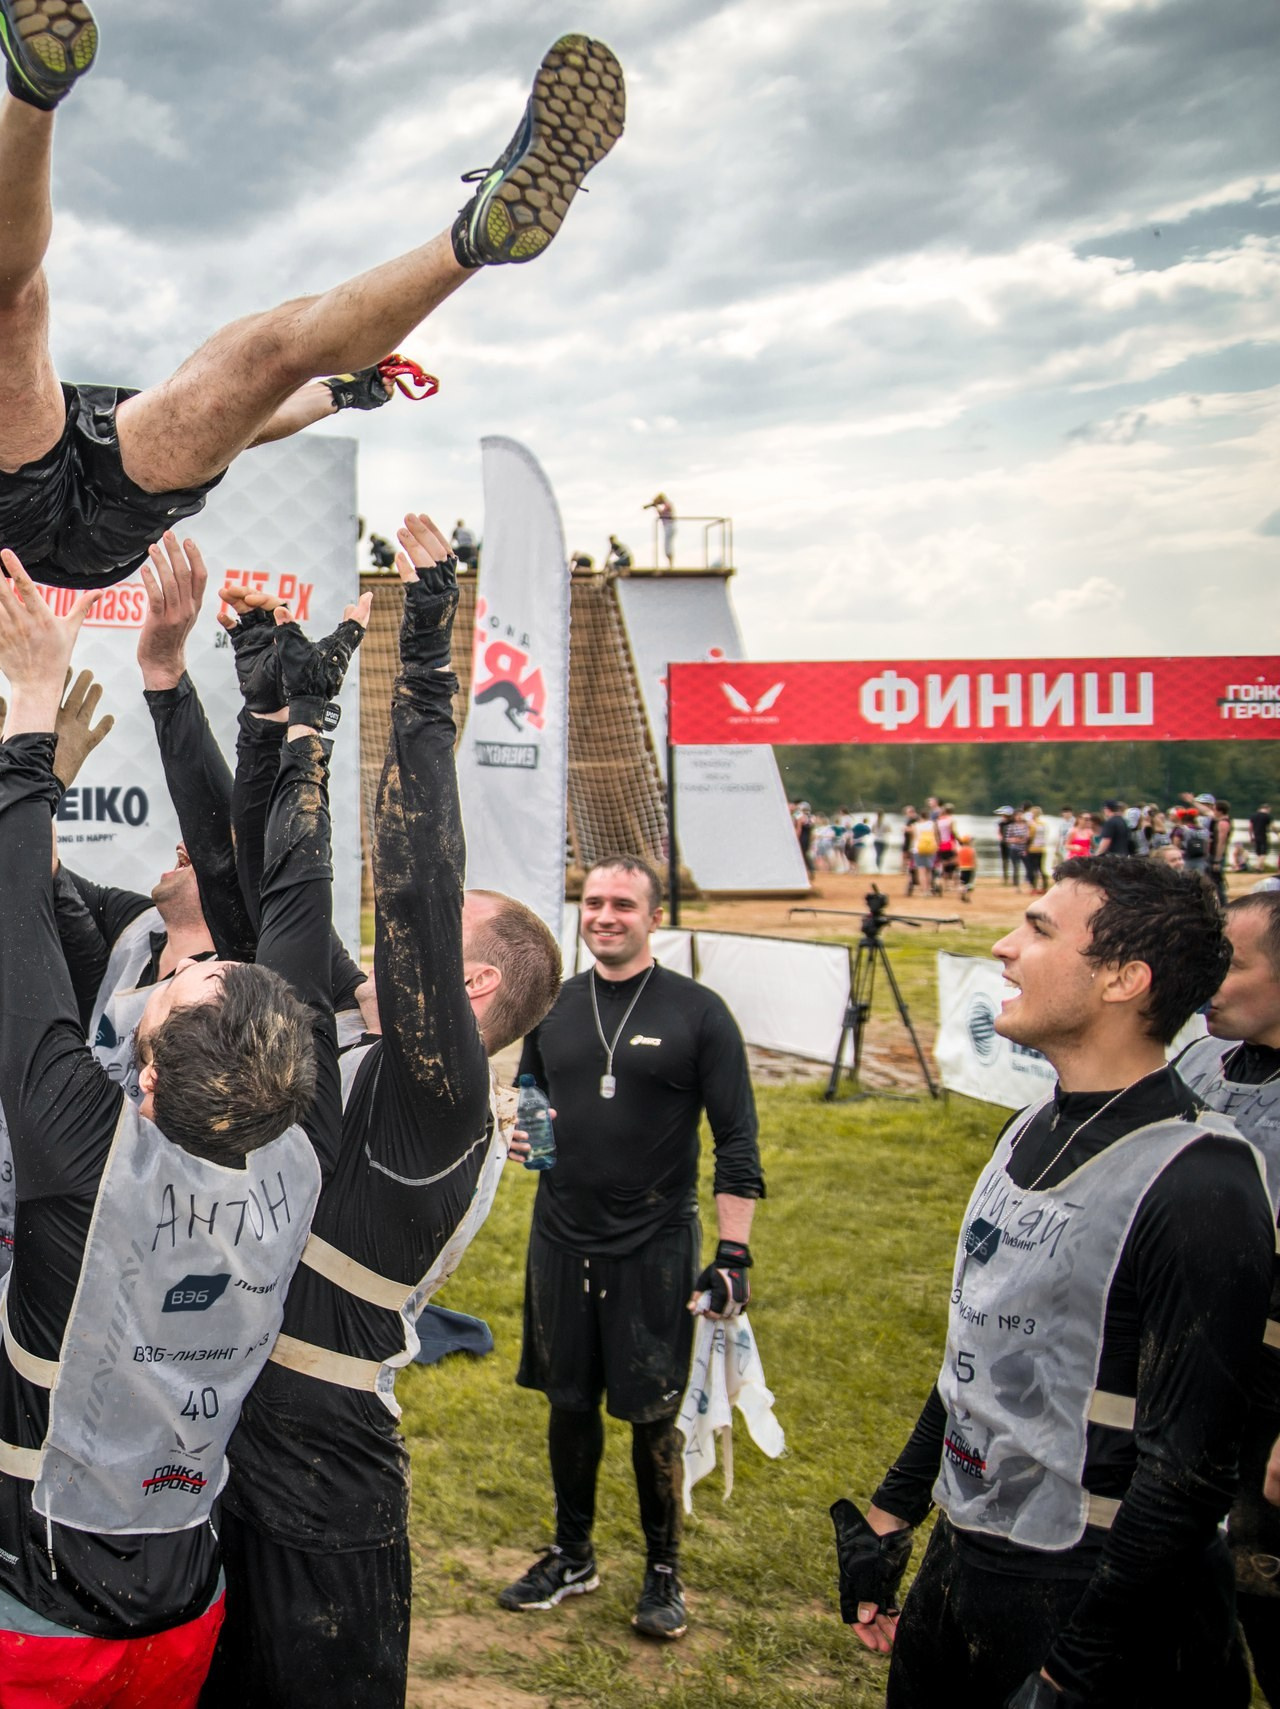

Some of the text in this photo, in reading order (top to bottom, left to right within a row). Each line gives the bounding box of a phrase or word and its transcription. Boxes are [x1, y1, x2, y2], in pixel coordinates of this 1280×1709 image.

[859, 670, 1154, 731] ФИНИШ
[151, 1171, 291, 1252] АНТОН
[180, 1386, 220, 1421] 40
[144, 1477, 203, 1496] ГЕРОЕВ
[152, 1464, 204, 1482] ГОНКА
